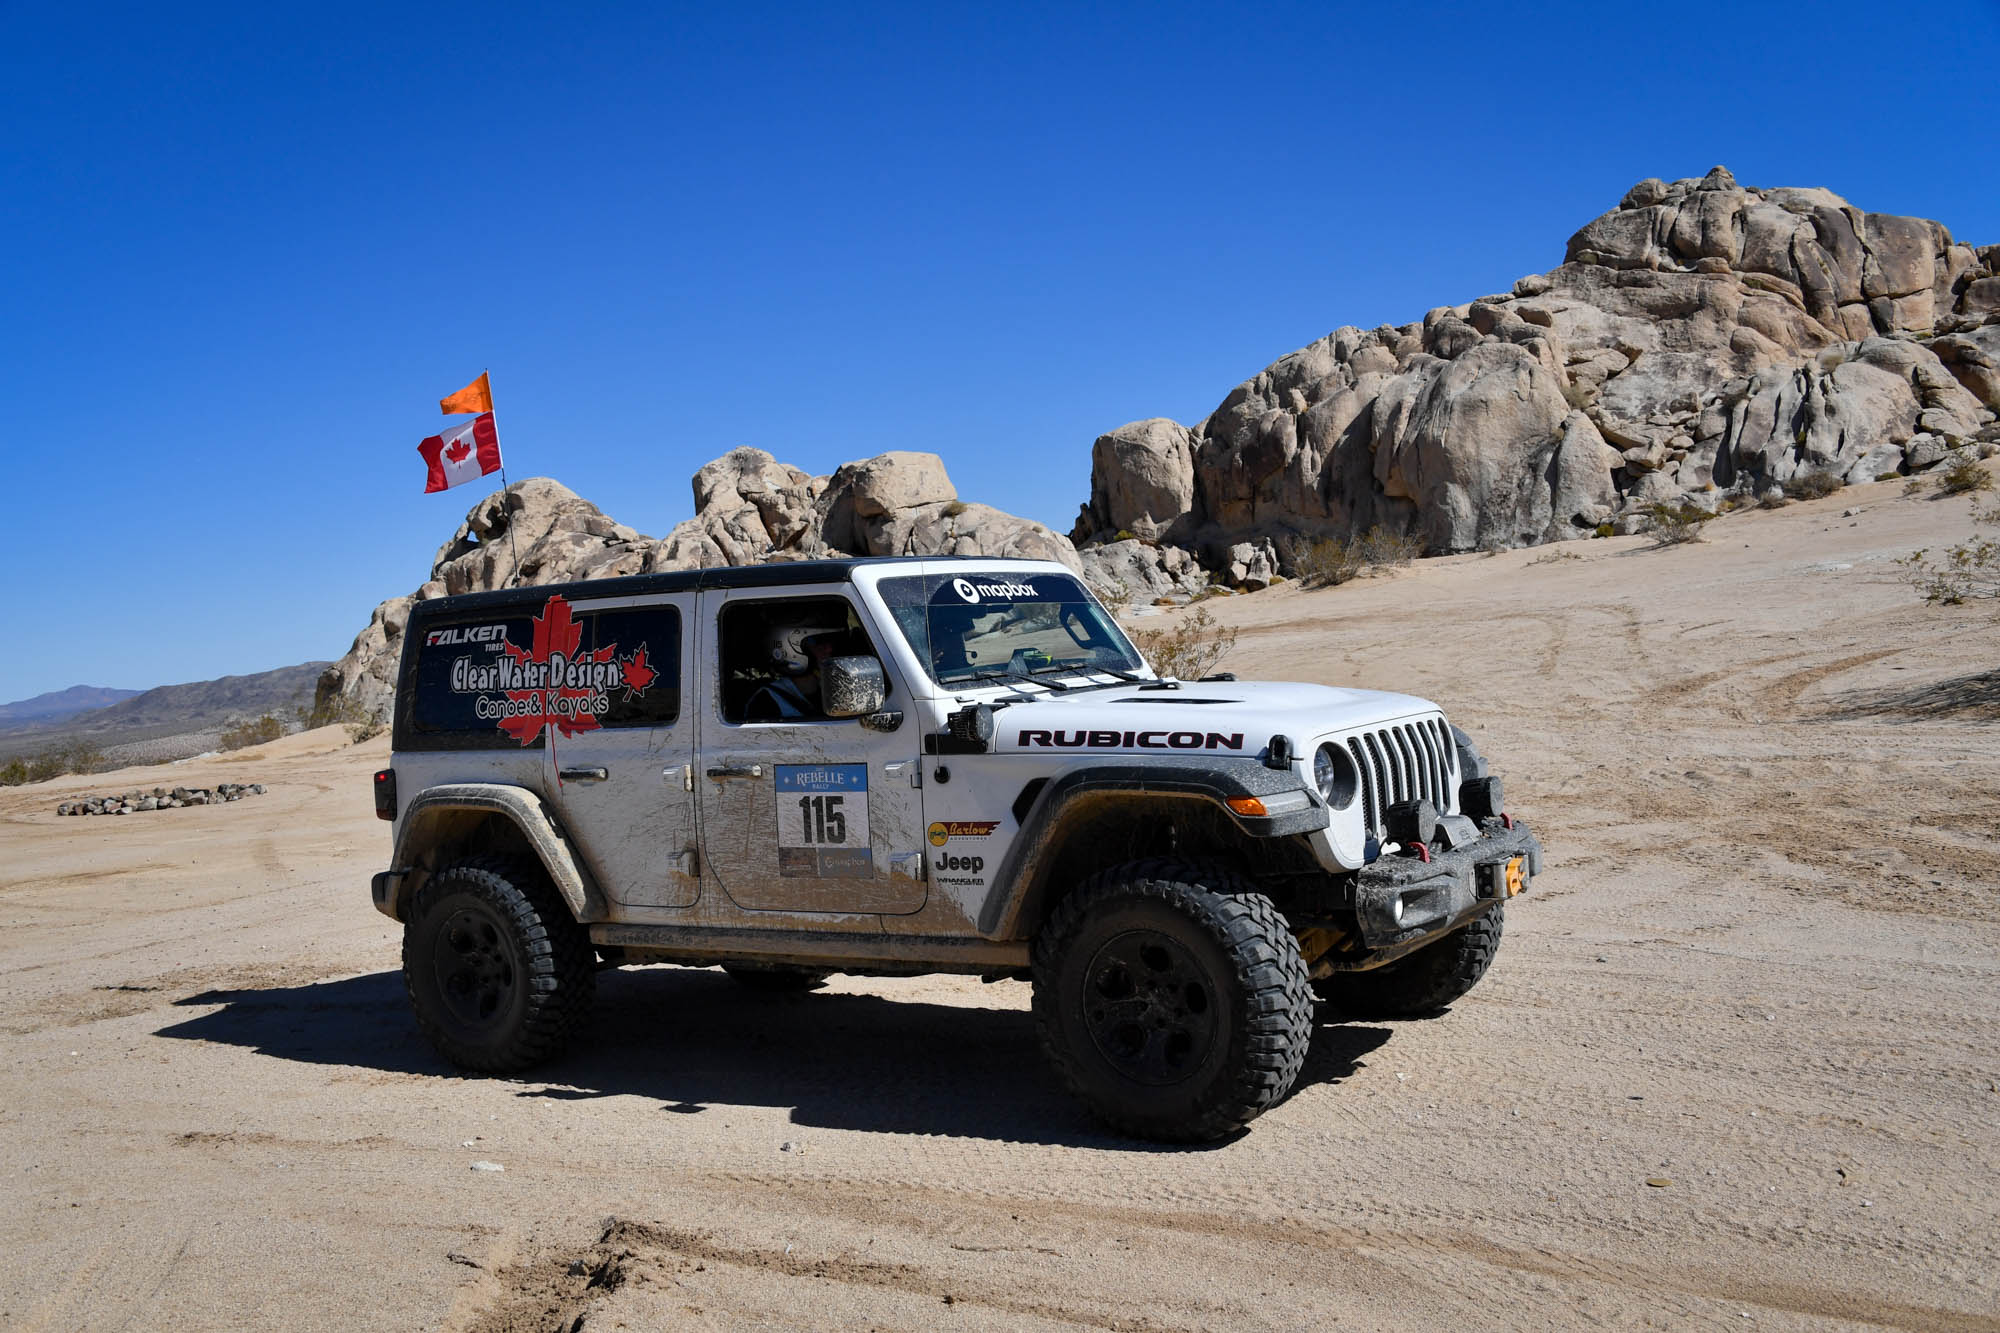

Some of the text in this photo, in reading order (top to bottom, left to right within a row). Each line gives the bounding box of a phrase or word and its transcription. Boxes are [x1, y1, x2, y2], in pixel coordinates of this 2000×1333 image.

[976, 581, 1039, 600] mapbox
[427, 625, 507, 646] FALKEN
[485, 643, 505, 652] TIRES
[549, 653, 620, 694] Design
[530, 692, 543, 715] &
[545, 691, 609, 720] Kayaks
[1018, 729, 1245, 750] RUBICON
[796, 771, 845, 787] REBELLE
[799, 796, 846, 844] 115
[949, 822, 988, 835] Barlow
[935, 851, 984, 874] Jeep
[936, 876, 984, 884] WRANGLER
